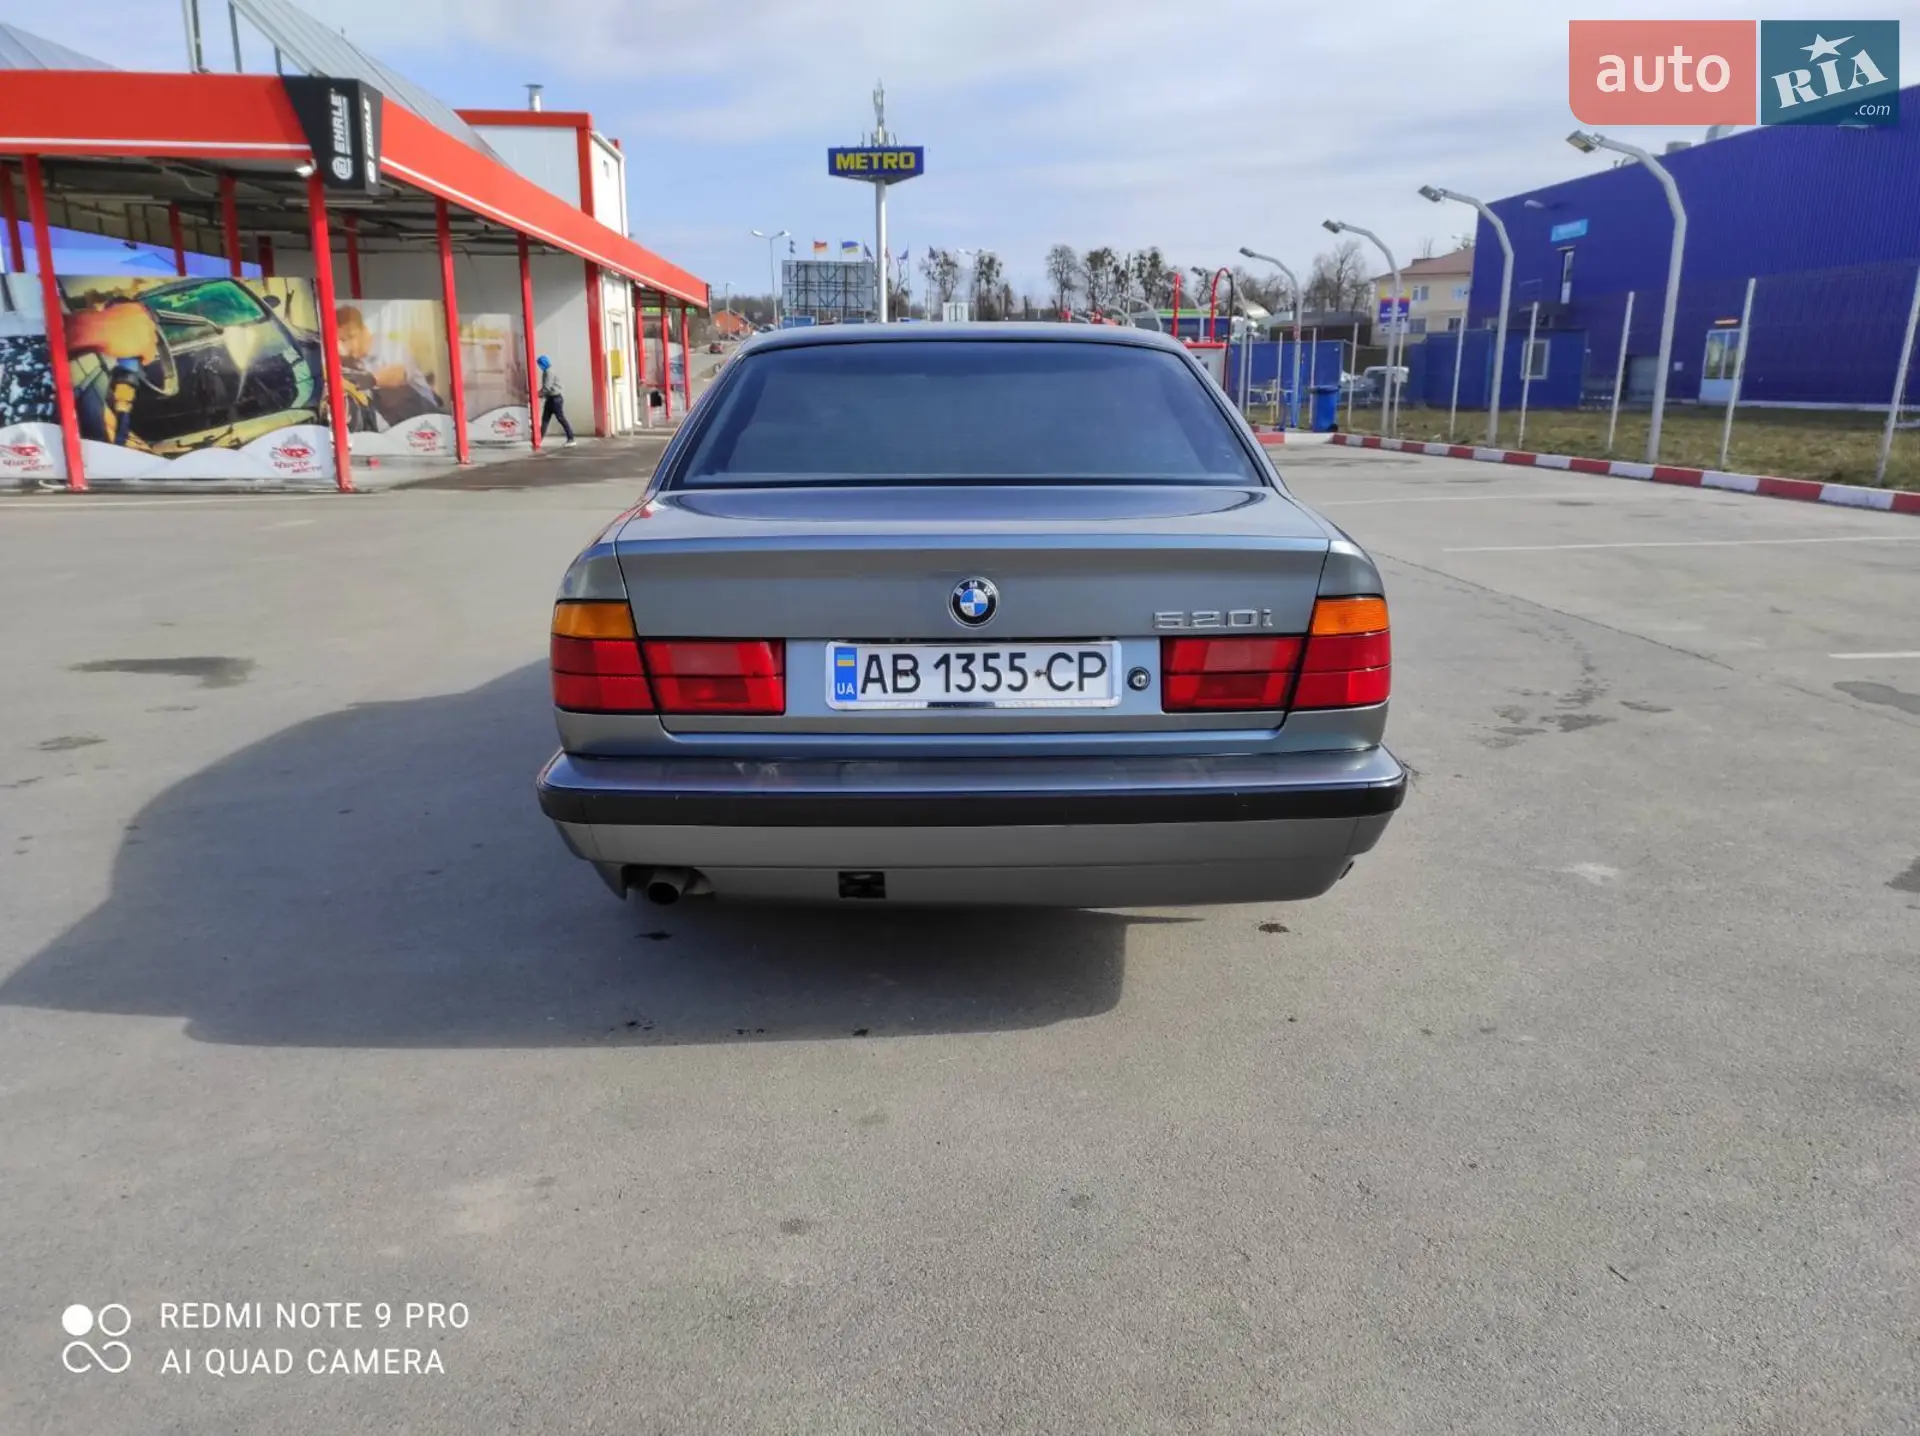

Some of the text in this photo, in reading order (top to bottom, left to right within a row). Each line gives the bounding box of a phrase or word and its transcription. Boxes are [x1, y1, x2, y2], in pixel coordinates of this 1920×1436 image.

[330, 93, 346, 154] EHRLE
[835, 151, 916, 171] METRO
[1153, 608, 1273, 629] 520i
[860, 651, 1107, 694] AB 1355 CP
[836, 682, 855, 695] UA
